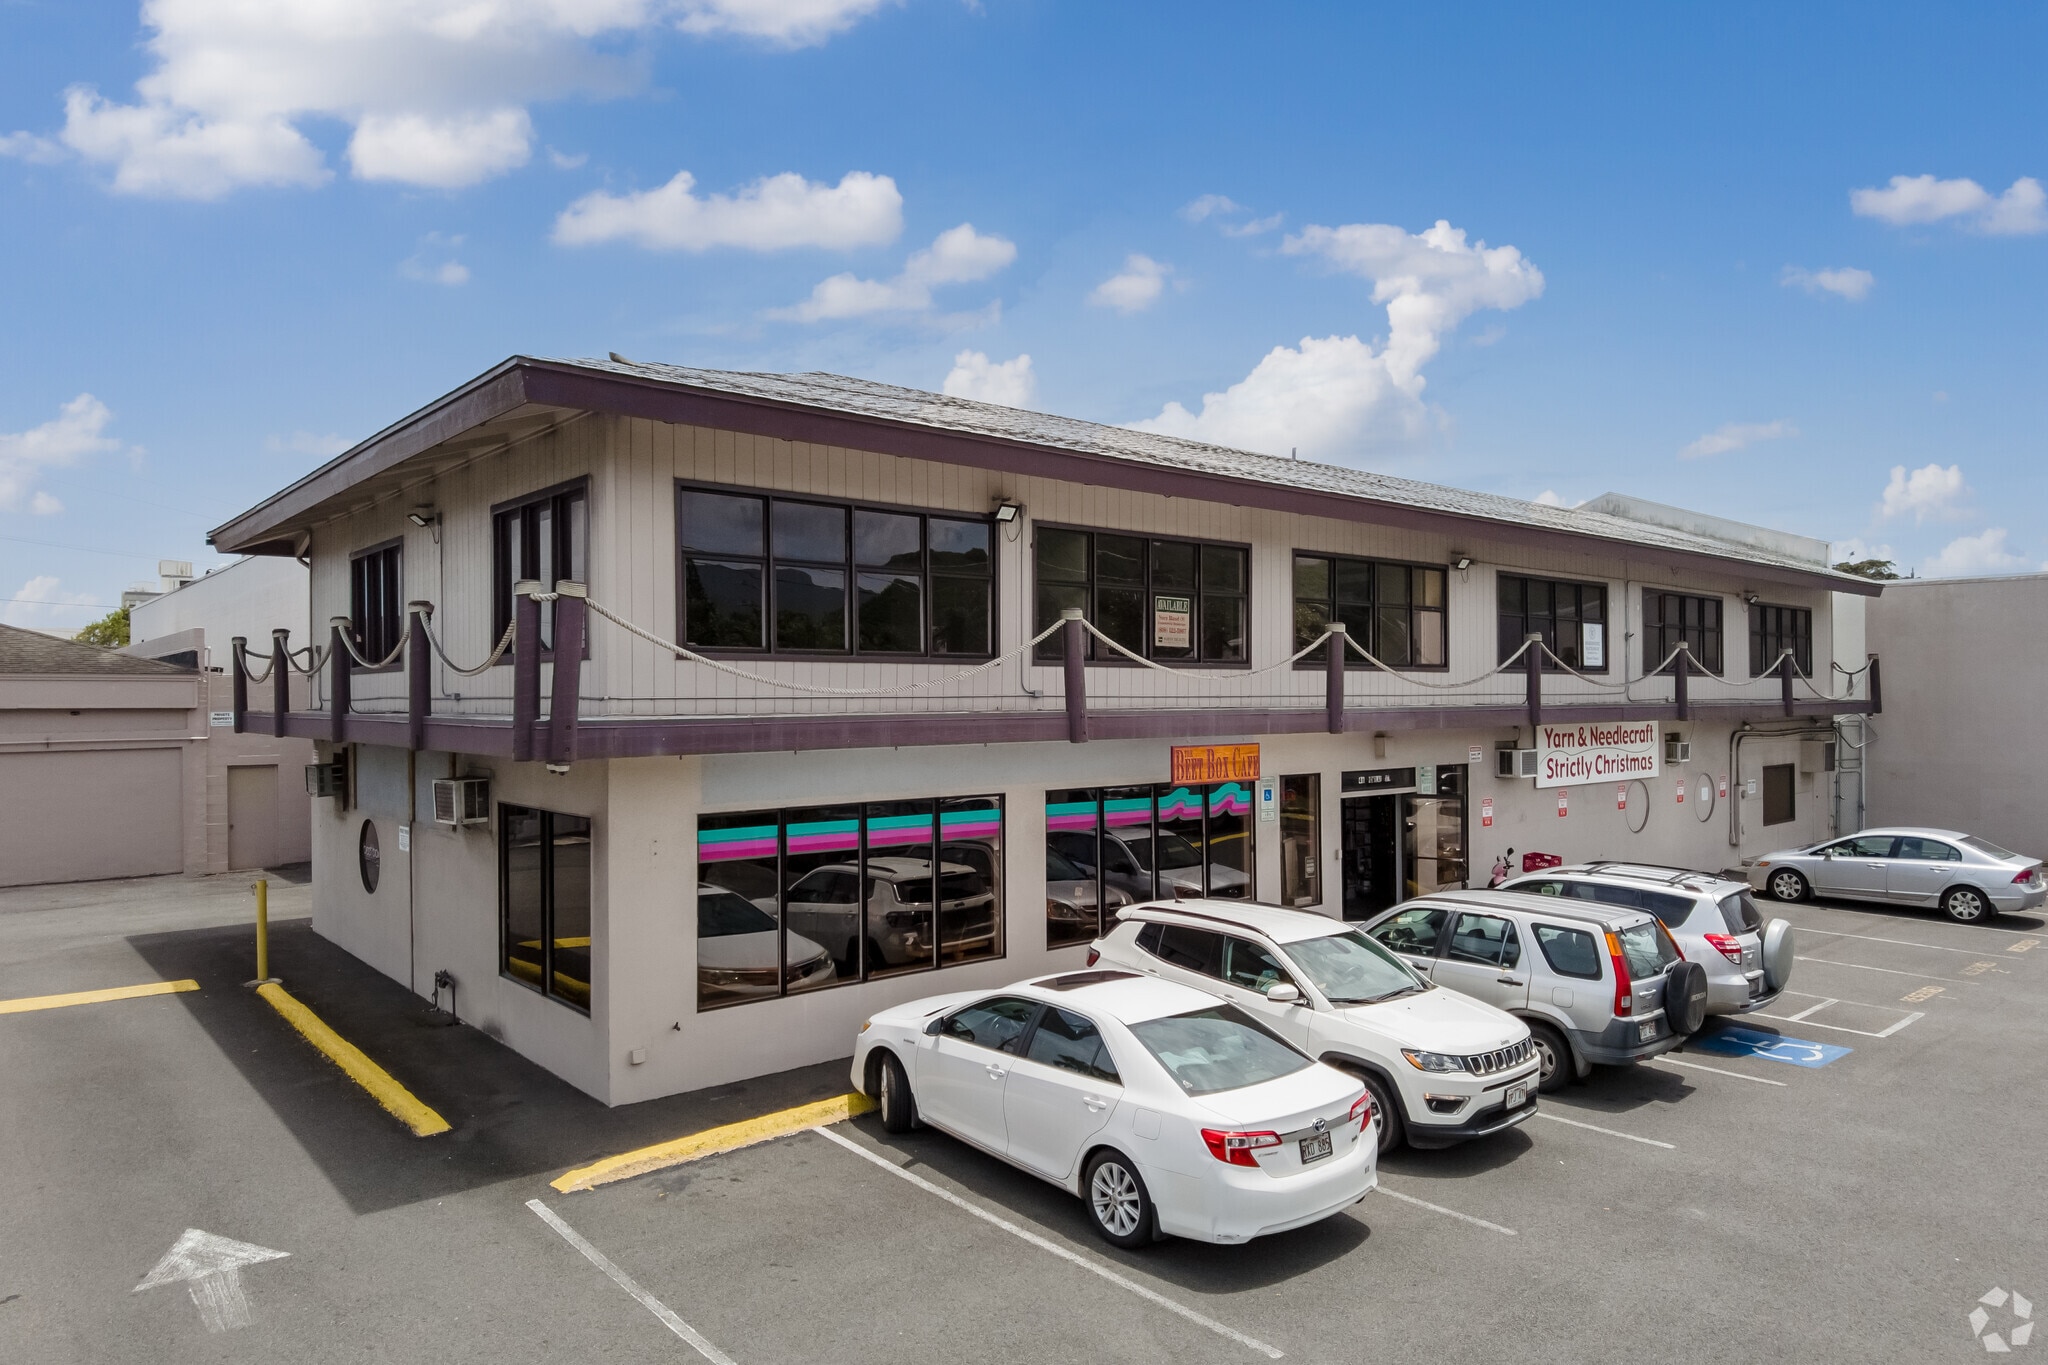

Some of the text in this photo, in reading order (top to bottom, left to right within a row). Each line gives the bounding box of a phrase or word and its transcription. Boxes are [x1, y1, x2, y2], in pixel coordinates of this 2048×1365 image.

[1544, 724, 1654, 749] Yarn & Needlecraft
[1175, 749, 1204, 781] BEET
[1207, 748, 1229, 779] BOX
[1546, 754, 1653, 780] Strictly Christmas
